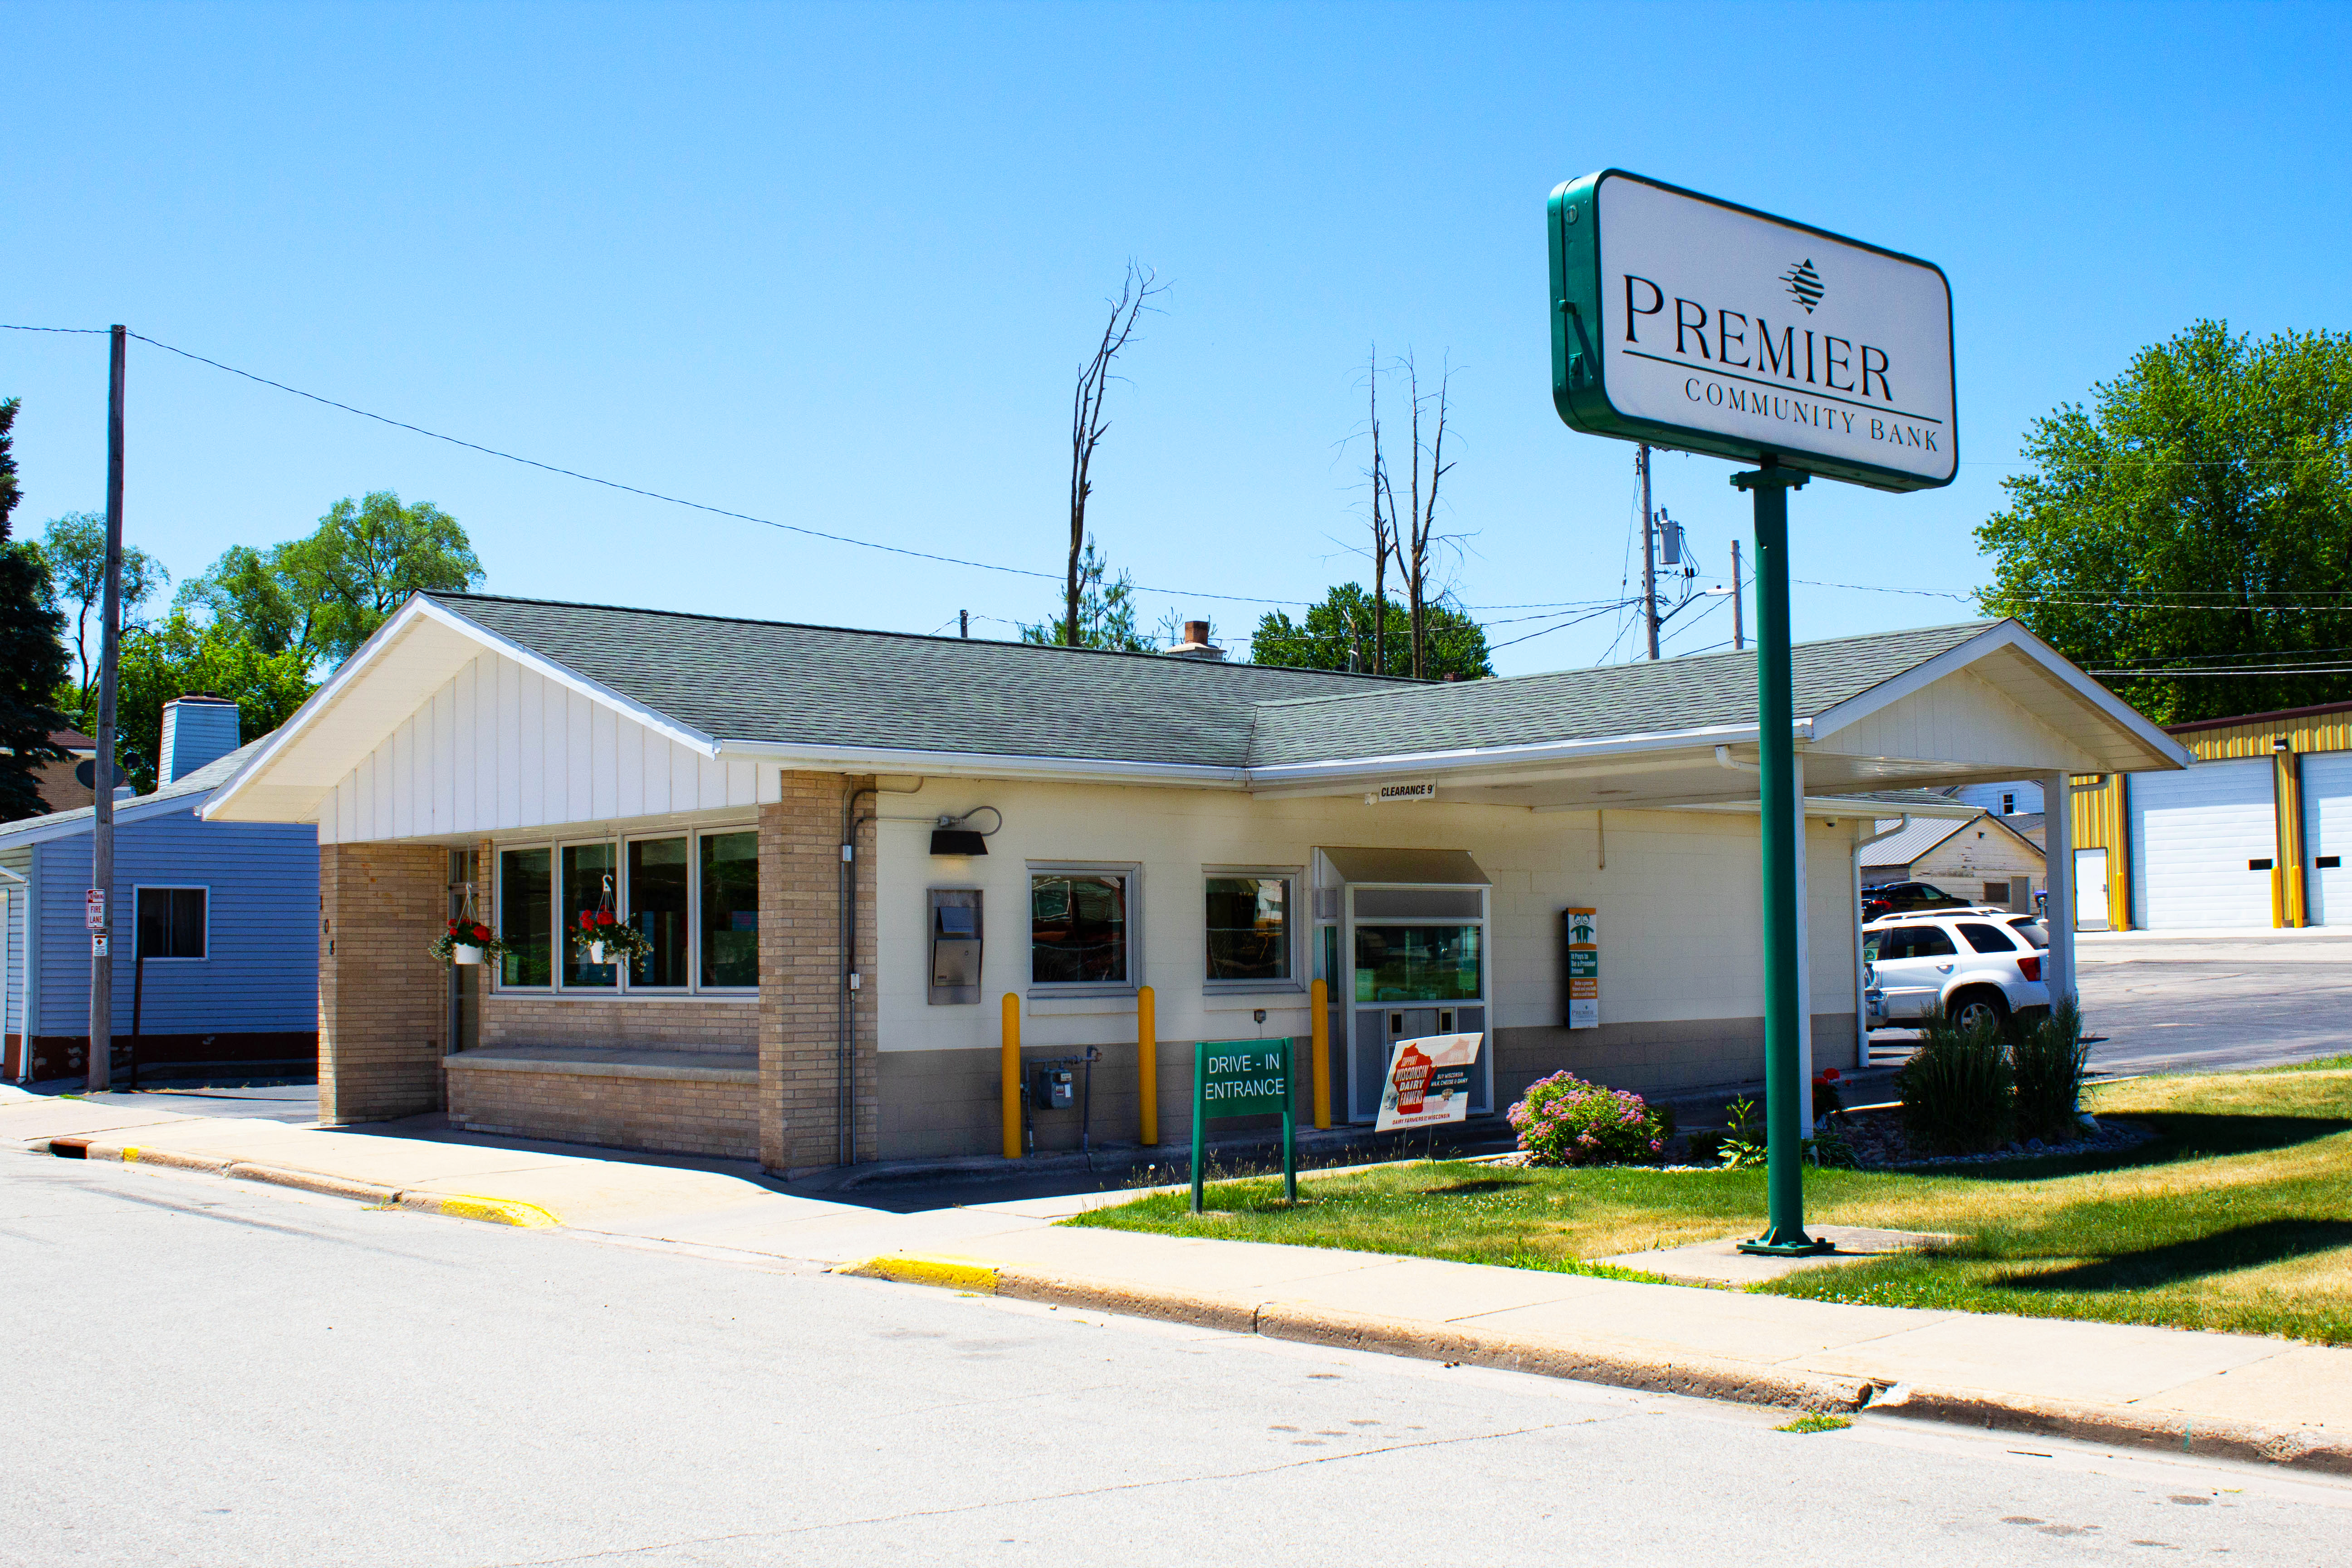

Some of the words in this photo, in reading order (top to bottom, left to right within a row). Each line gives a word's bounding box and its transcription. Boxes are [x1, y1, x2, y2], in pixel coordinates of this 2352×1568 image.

[1622, 274, 1894, 402] PREMIER
[1685, 378, 1856, 435] COMMUNITY
[1871, 418, 1938, 452] BANK
[1381, 784, 1425, 797] CLEARANCE
[1209, 1055, 1251, 1074] DRIVE
[1265, 1053, 1279, 1070] IN
[1401, 1055, 1418, 1067] SUPPORT
[1395, 1064, 1429, 1082] WISCONSIN
[1205, 1078, 1285, 1100] ENTRANCE
[1399, 1079, 1425, 1092] DAIRY
[1400, 1089, 1424, 1107] FARMERS
